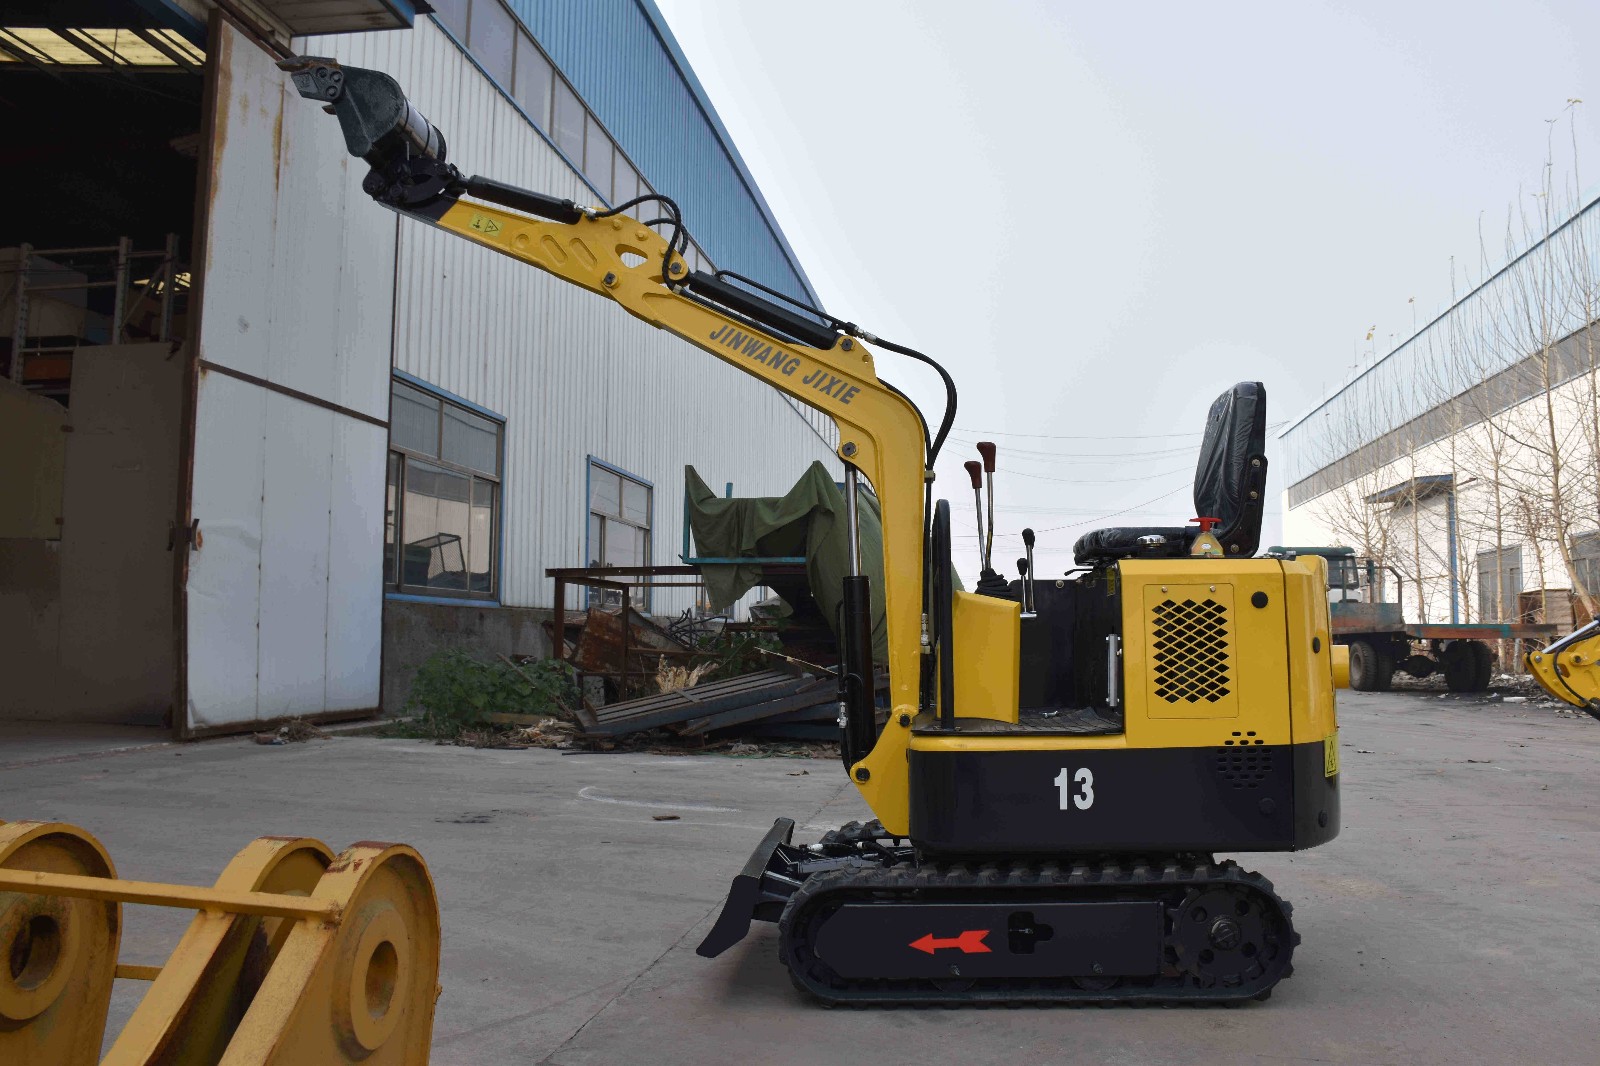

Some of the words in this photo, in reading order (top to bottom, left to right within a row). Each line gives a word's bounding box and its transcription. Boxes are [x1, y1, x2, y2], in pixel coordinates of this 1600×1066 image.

[709, 325, 801, 377] JINWANG
[802, 369, 861, 405] JIXIE
[1054, 767, 1095, 811] 13
